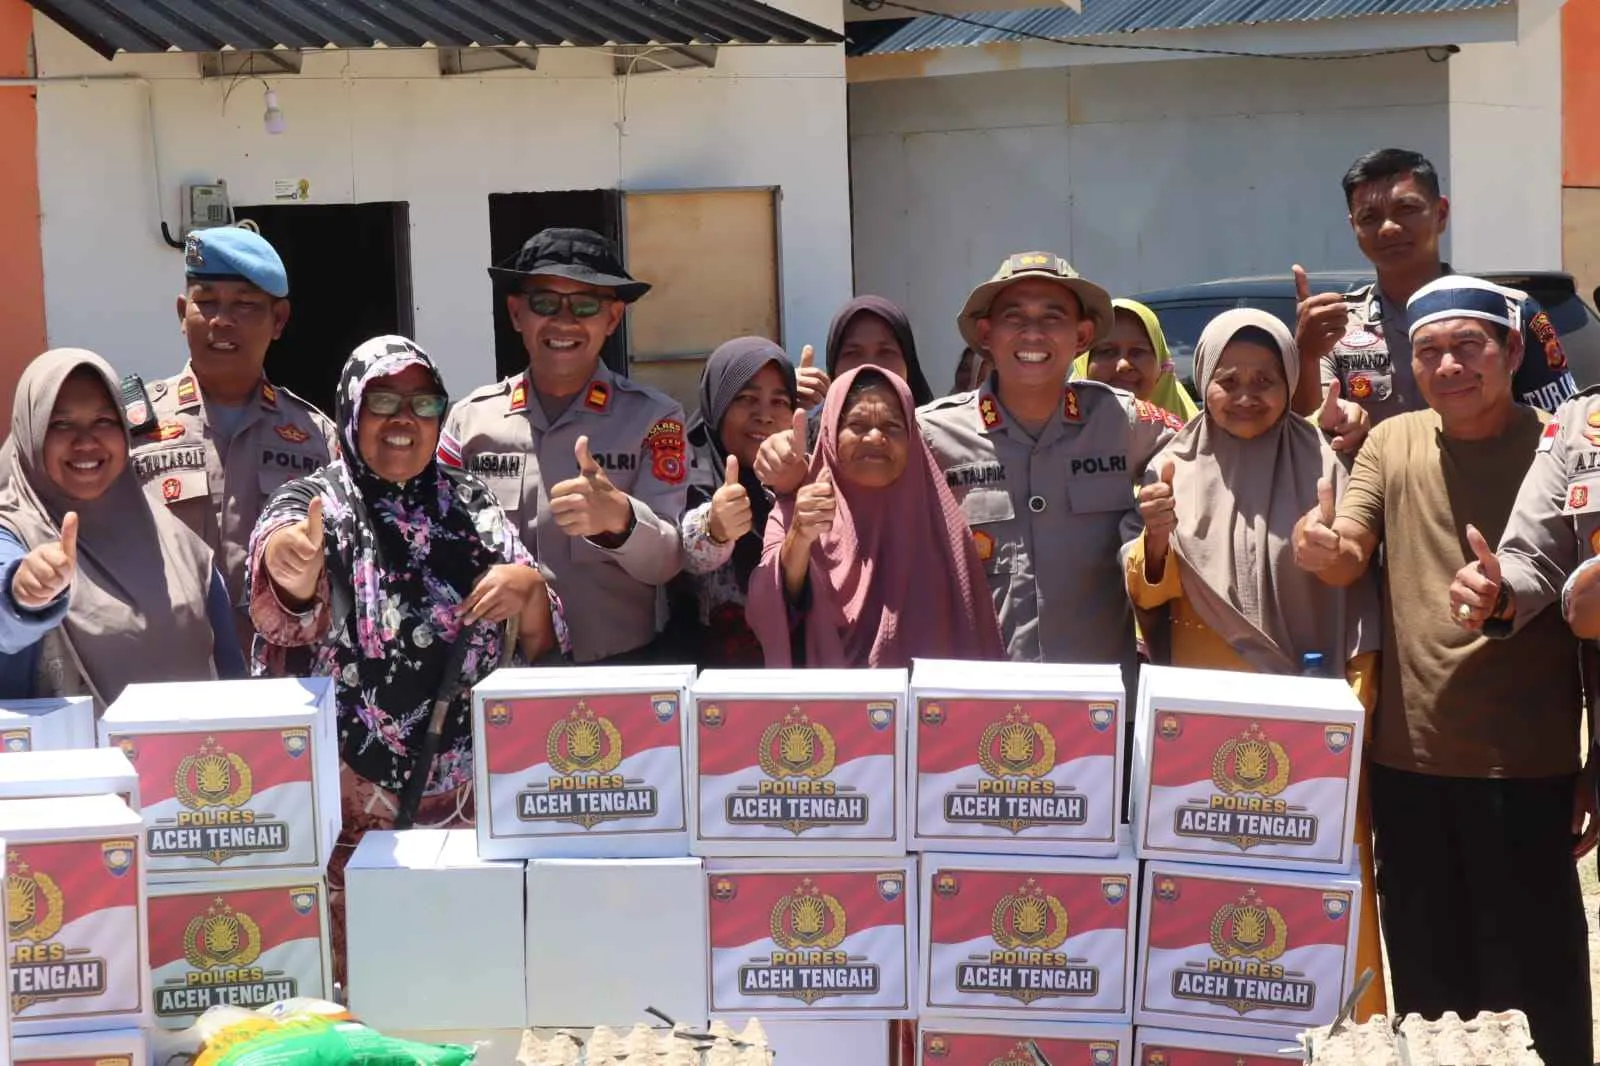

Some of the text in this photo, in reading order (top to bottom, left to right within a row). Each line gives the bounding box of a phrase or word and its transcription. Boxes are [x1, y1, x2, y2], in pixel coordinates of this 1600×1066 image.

[577, 453, 635, 471] OLRI
[1071, 456, 1127, 475] POLRI
[546, 775, 624, 792] POLRES
[759, 780, 836, 796] POLRES
[978, 779, 1055, 796] POLRES
[523, 790, 651, 815] ACEH TENGAH
[732, 798, 862, 818] ACEH TENGAH
[950, 796, 1080, 818] ACEH TENGAH
[1210, 794, 1286, 815] POLRES
[178, 809, 255, 827] POLRES
[1181, 810, 1311, 838] ACEH TENGAH
[152, 826, 283, 850] ACEH TENGAH
[10, 943, 64, 962] RES
[771, 951, 847, 967] POLRES
[991, 950, 1067, 967] POLRES
[8, 963, 98, 992] TENGAH
[187, 968, 263, 986] POLRES
[745, 968, 873, 989] ACEH TENGAH
[962, 966, 1093, 990] ACEH TENGAH
[1207, 959, 1284, 979] POLRES
[162, 981, 291, 1010] ACEH TENGAH
[1178, 973, 1309, 1004] ACEH TENGAH
